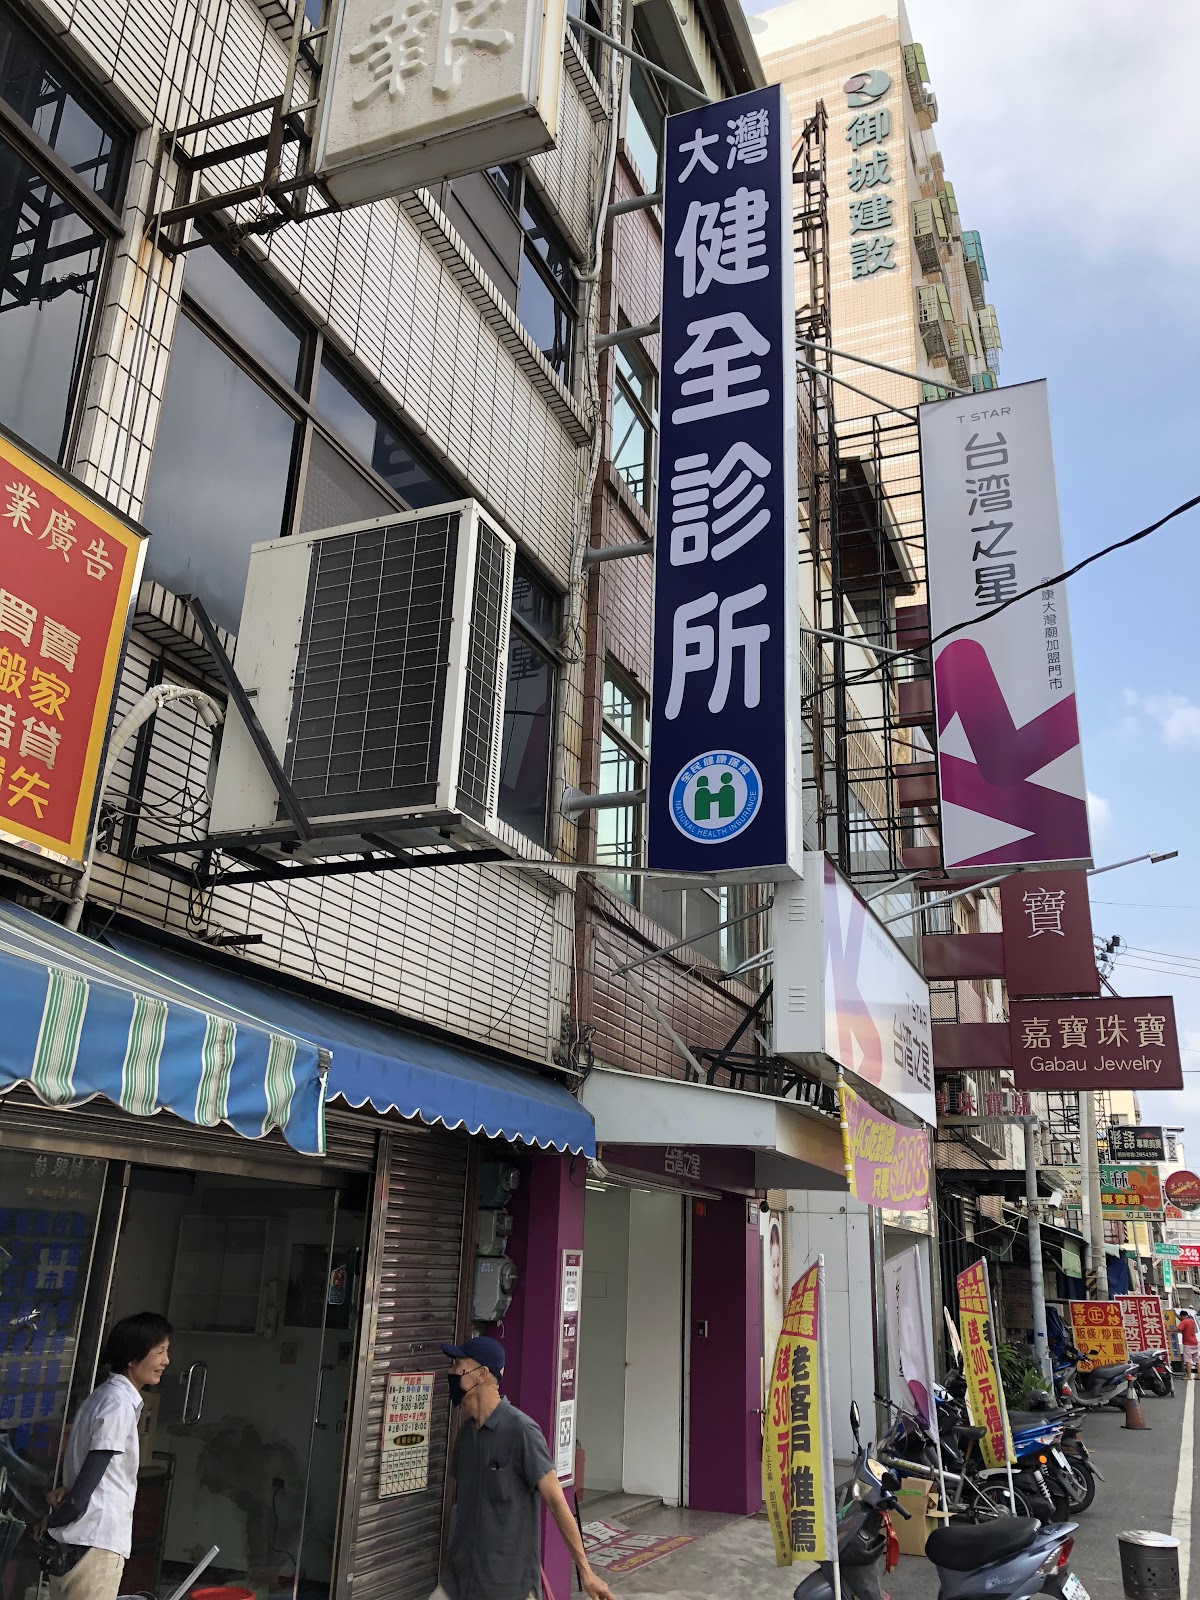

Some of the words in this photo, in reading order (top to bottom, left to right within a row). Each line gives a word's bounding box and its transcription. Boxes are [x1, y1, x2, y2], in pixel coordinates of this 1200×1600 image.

[678, 108, 769, 183] 大灣
[845, 108, 896, 279] 御城建設
[971, 407, 1011, 422] STAR
[665, 187, 771, 720] 健全診所
[0, 755, 50, 819] 失
[676, 800, 695, 833] NATIONAL
[697, 828, 728, 838] HEALTH
[728, 790, 757, 832] INSURANCE
[1021, 1013, 1166, 1049] 嘉寶珠寶
[1030, 1056, 1087, 1072] Gabau
[1094, 1055, 1162, 1074] Jewelry
